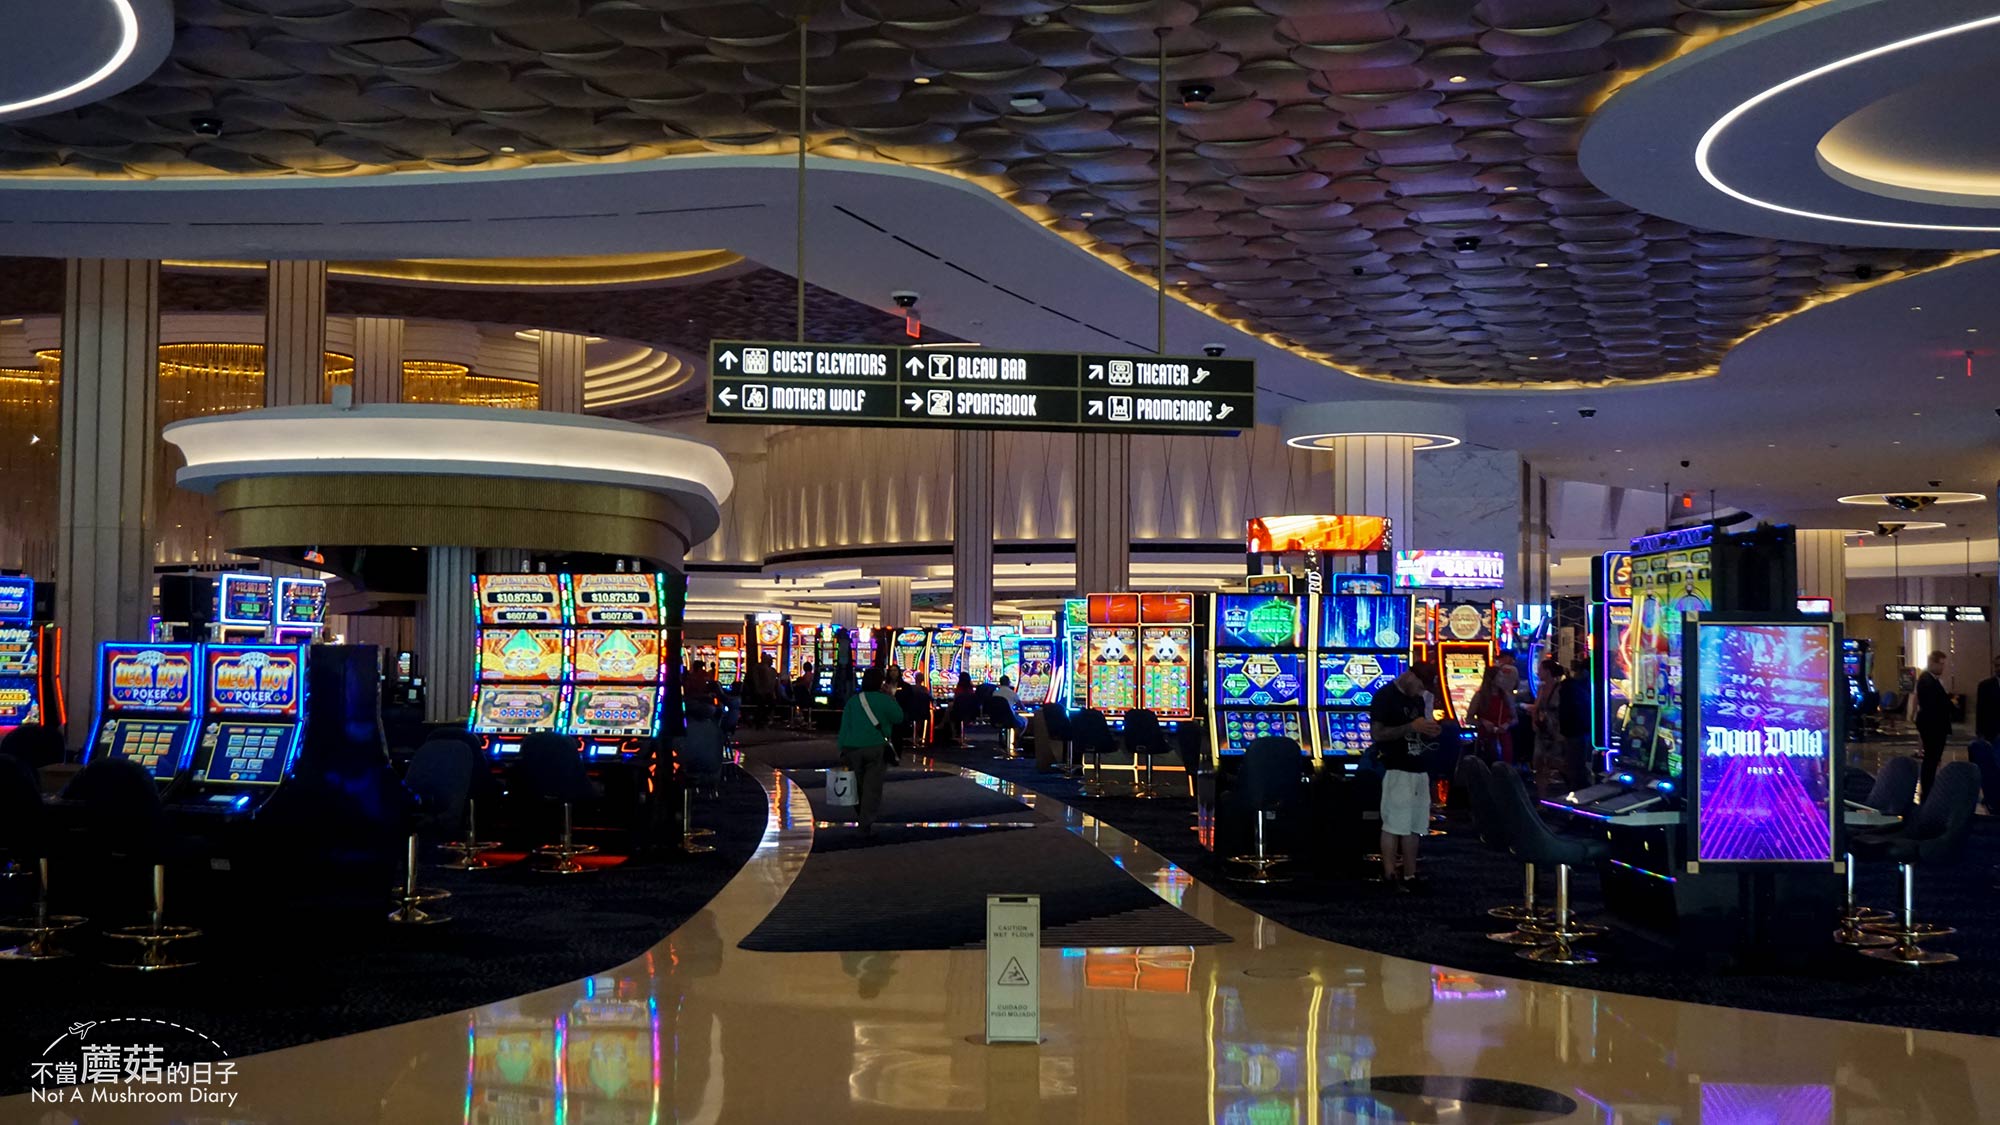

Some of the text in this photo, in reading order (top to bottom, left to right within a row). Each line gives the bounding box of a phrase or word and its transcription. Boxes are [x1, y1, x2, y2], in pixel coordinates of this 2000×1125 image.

[772, 350, 887, 376] GUEST ELEVATORS
[957, 356, 1027, 381] BLEAU BAR
[1136, 363, 1190, 386] THEATER
[772, 387, 866, 411] MOTHER WOLF
[956, 392, 1037, 416] SPORTSBOOK
[1136, 398, 1213, 422] PROMENADE
[1251, 607, 1291, 621] FREE
[1248, 621, 1292, 633] GAMES
[115, 663, 188, 689] MEGA HOT
[217, 665, 293, 691] MEGA HOT
[132, 688, 168, 700] POKER
[235, 690, 273, 703] POKER
[1717, 702, 1806, 721] 2024
